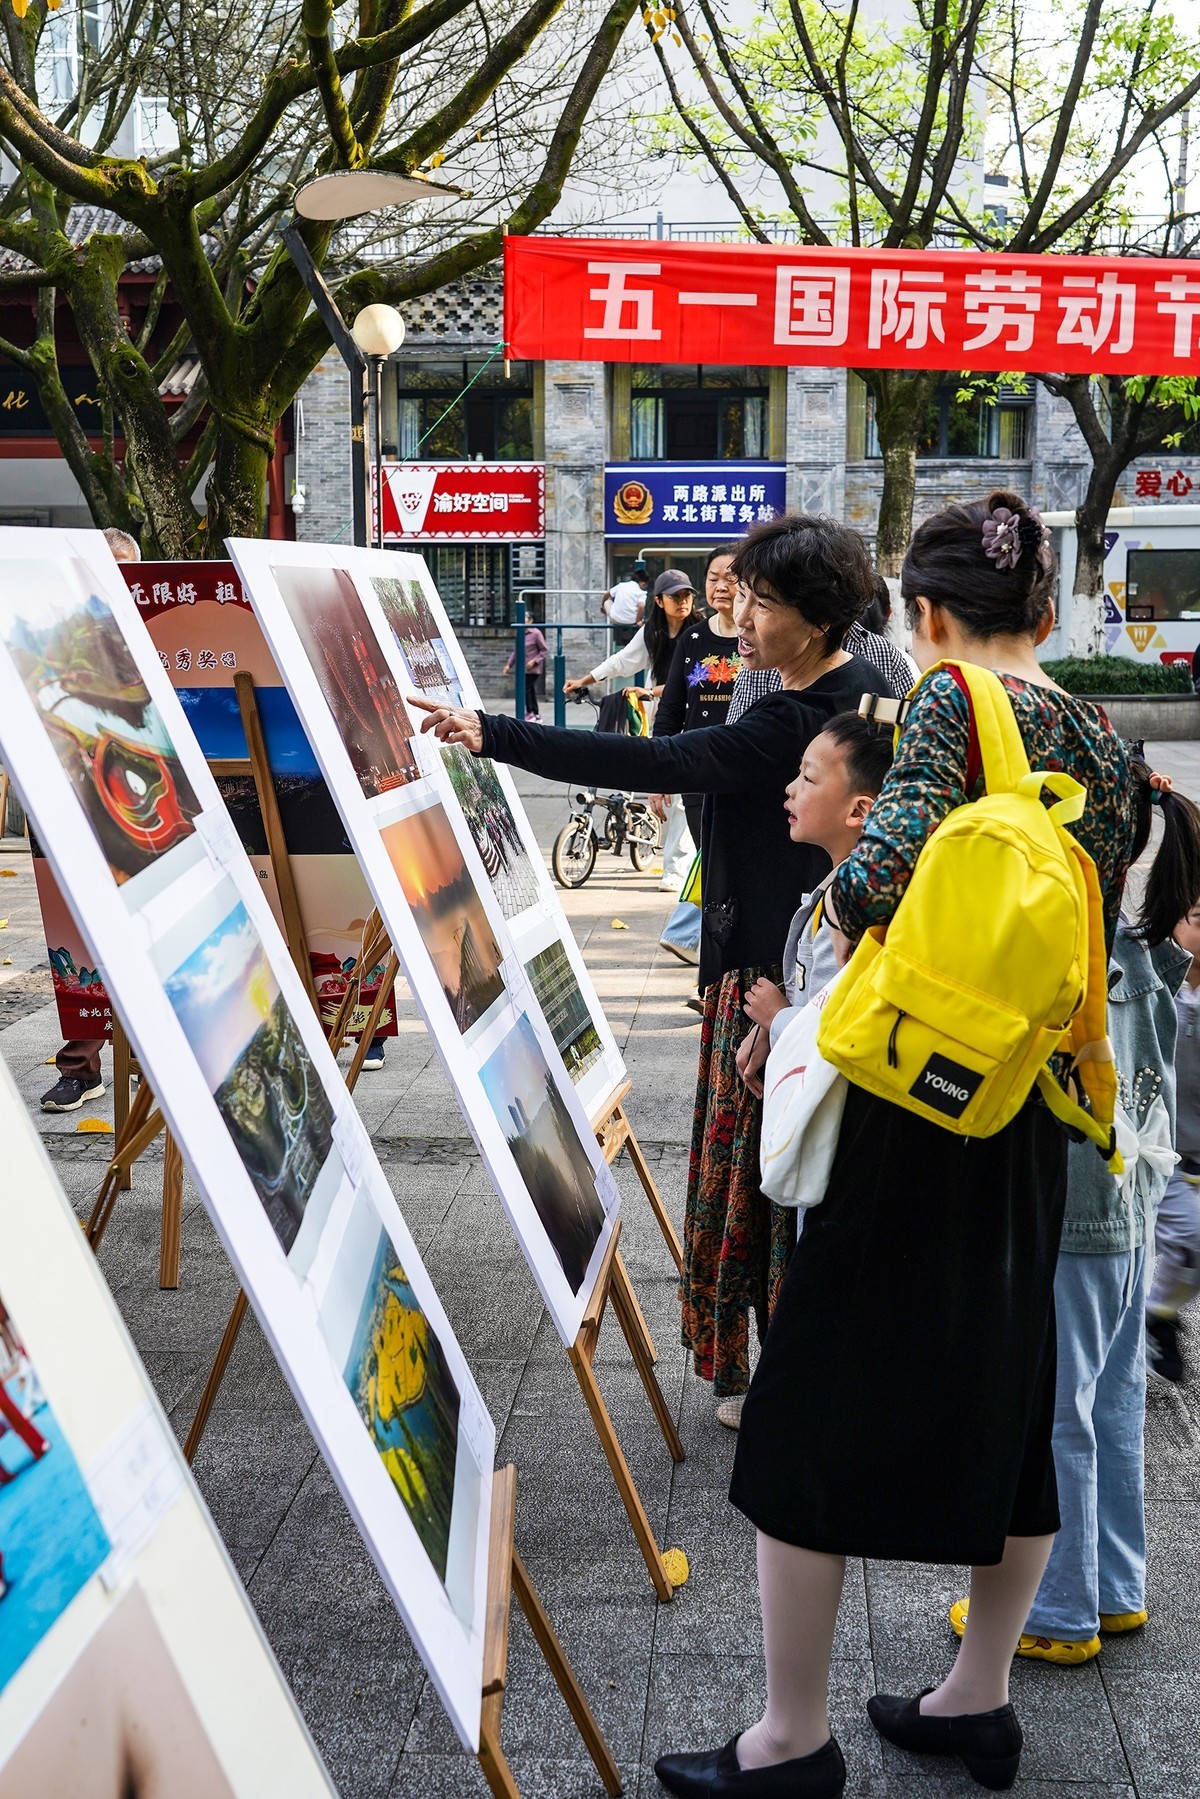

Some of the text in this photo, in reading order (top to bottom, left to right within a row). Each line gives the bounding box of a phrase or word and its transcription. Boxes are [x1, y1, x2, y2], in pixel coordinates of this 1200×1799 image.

[583, 261, 1200, 358] 五一国际劳动节
[673, 485, 766, 502] 两路派出所
[1135, 469, 1193, 497] 爱心
[433, 492, 509, 513] 渝好空间
[662, 505, 775, 522] 双北街警务站
[215, 581, 250, 603] 祖
[924, 1070, 970, 1101] YOUNG
